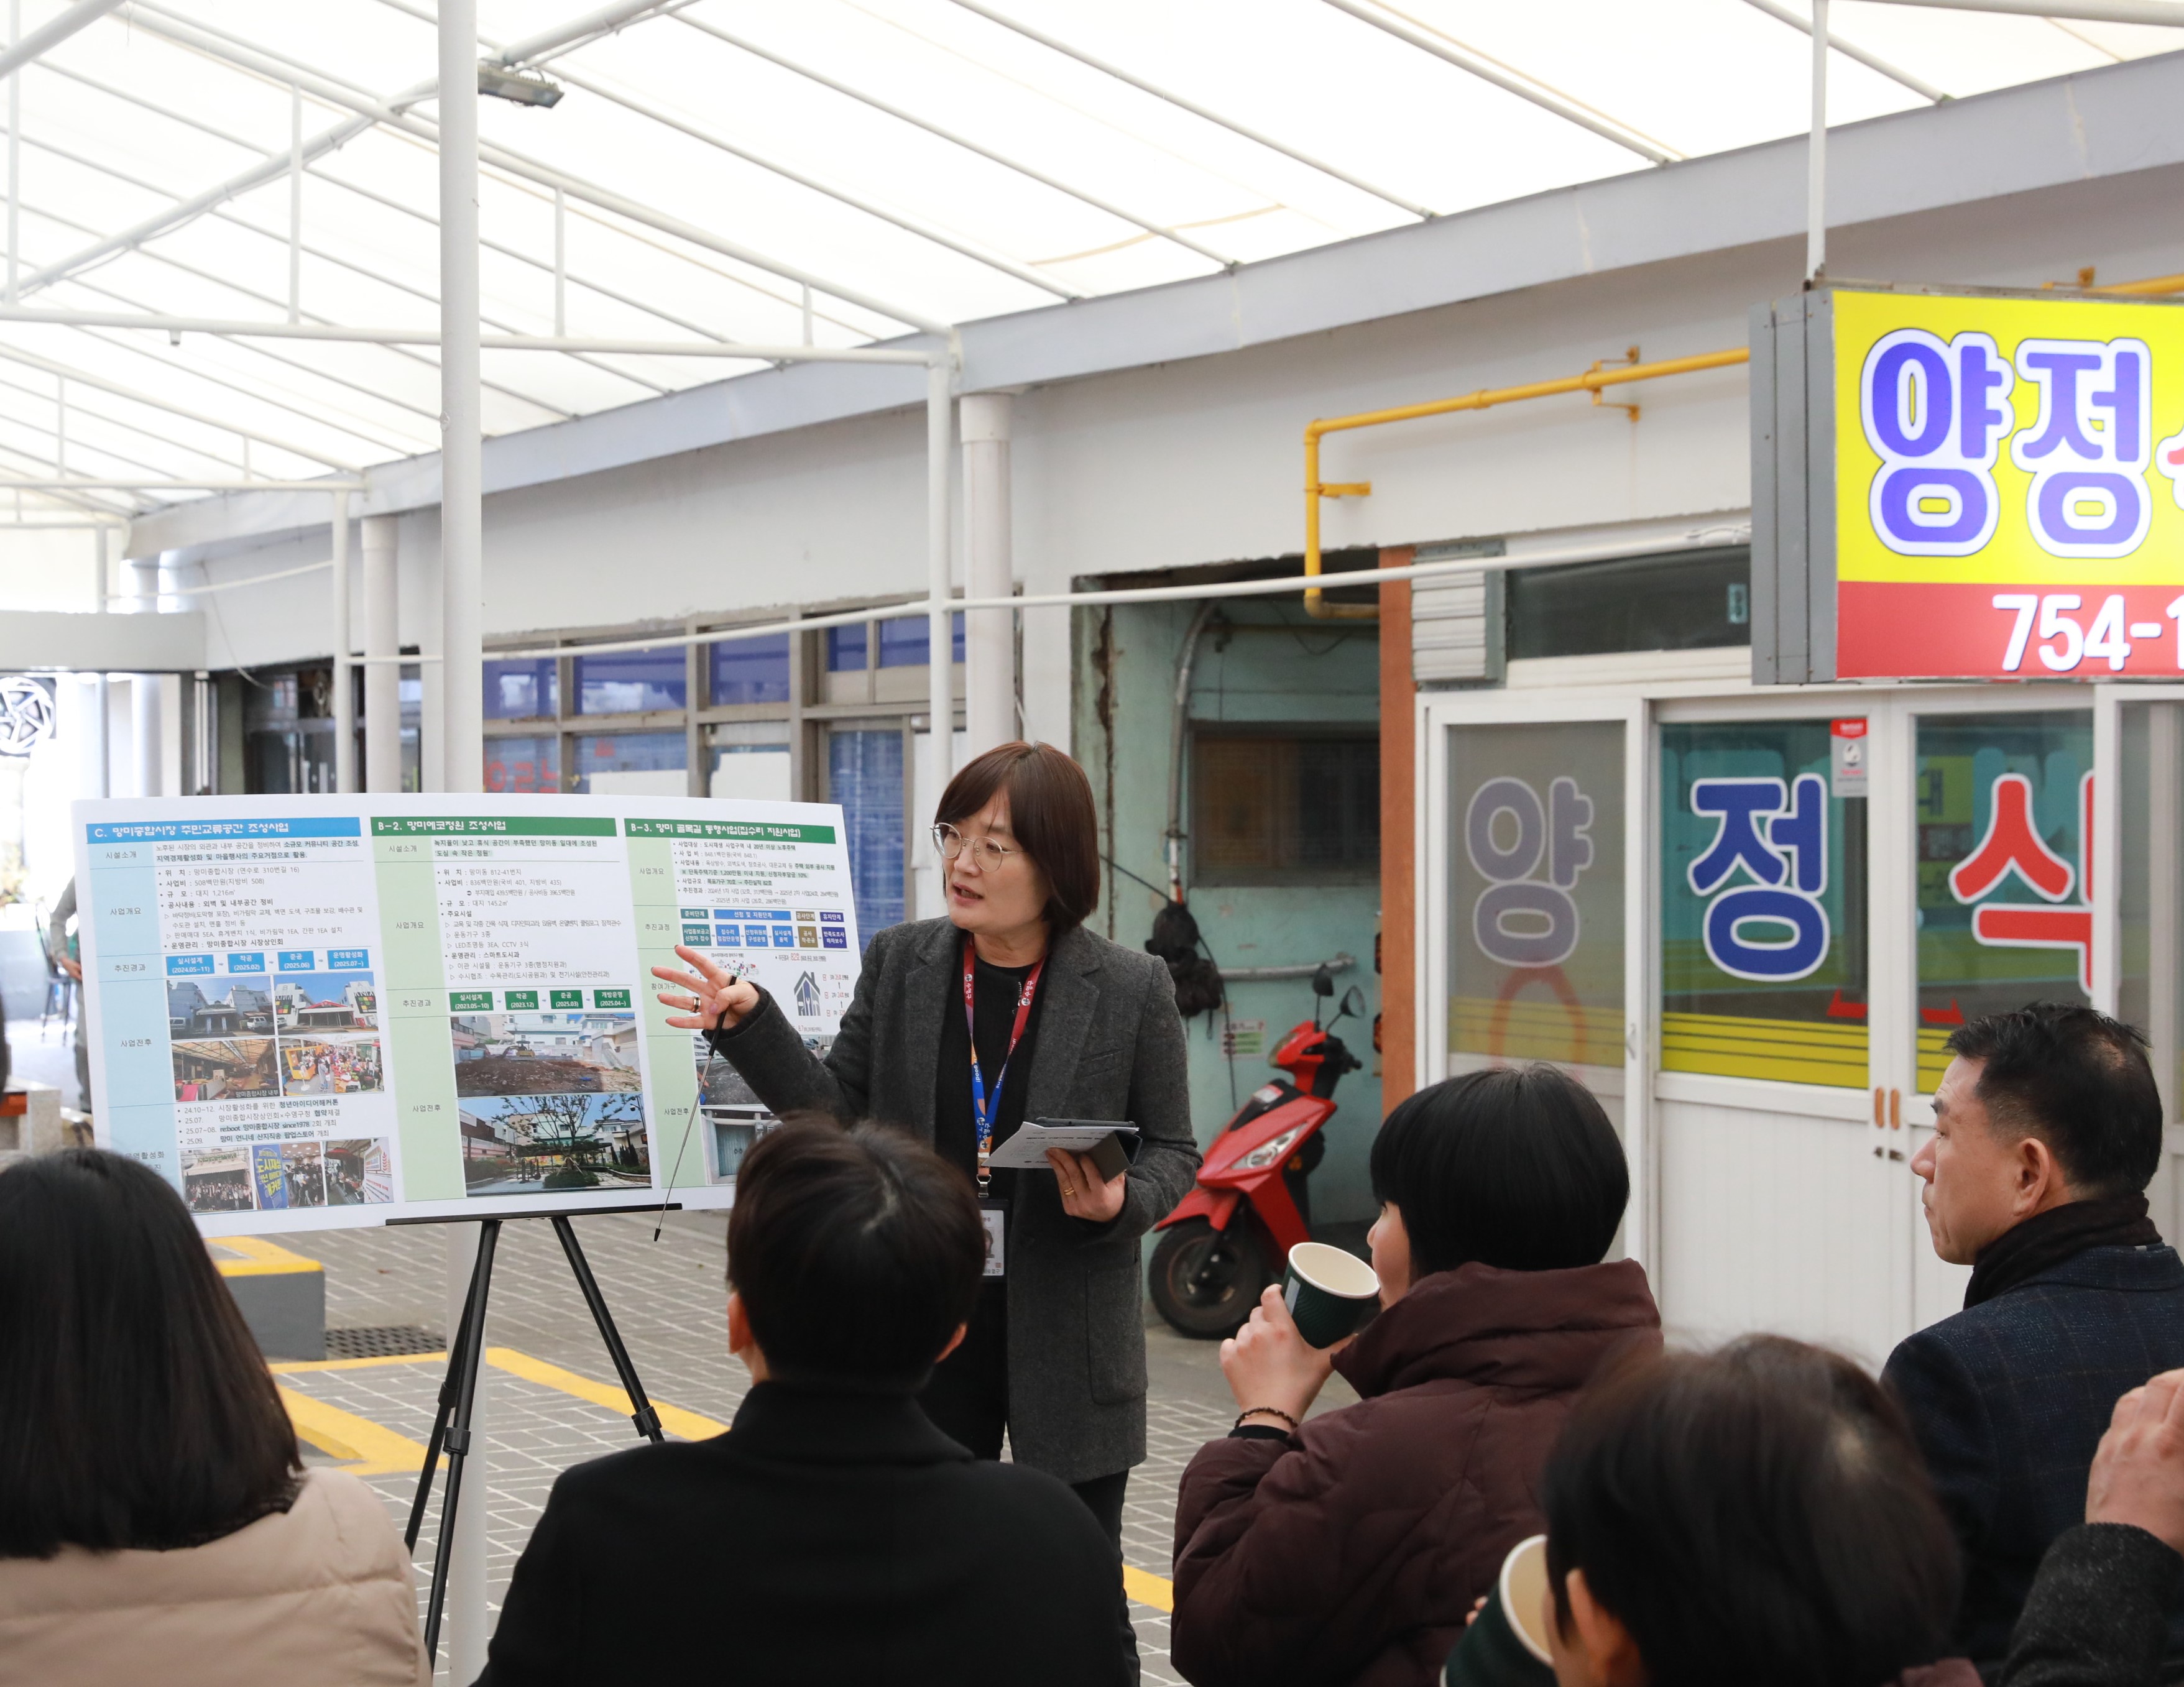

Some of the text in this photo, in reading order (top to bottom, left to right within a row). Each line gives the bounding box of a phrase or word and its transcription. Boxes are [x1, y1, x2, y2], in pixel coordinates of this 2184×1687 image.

[1861, 328, 2184, 558] 양정
[1993, 594, 2184, 671] 754-1
[94, 822, 289, 837] C. 망미종합시장 주민교류공간 조성사업
[377, 821, 506, 831] B-2. 망미에코정원 조성사업
[630, 823, 652, 832] B-3.
[656, 824, 673, 833] 망미
[676, 824, 701, 834] 골목길
[767, 827, 801, 838] 지원사업)
[106, 851, 137, 859] 시설소개
[156, 854, 203, 862] 지역경제활성화
[216, 852, 248, 860] 마을행사의
[194, 866, 234, 875] 망미종합시장
[237, 866, 259, 875] (연수로
[263, 866, 287, 874] 310번길
[230, 899, 257, 907] 내부공간
[110, 908, 142, 916] 사업개요
[171, 938, 283, 949] 운영관리 망미종합시장 시장상인회
[114, 964, 146, 972] 추진경과
[403, 999, 431, 1007] 추진경과
[121, 1039, 152, 1047] 사업전후
[236, 1090, 267, 1098] 망미종합시장
[219, 1102, 259, 1112] 시장활성화를
[279, 1099, 339, 1108] 청년아이디어해커톤
[314, 1109, 341, 1117] 협약체결
[243, 1122, 280, 1131] 망미종합시장
[236, 1134, 254, 1142] 언니네
[257, 1133, 282, 1141] 산지직송
[284, 1131, 315, 1139] 팝업스토어
